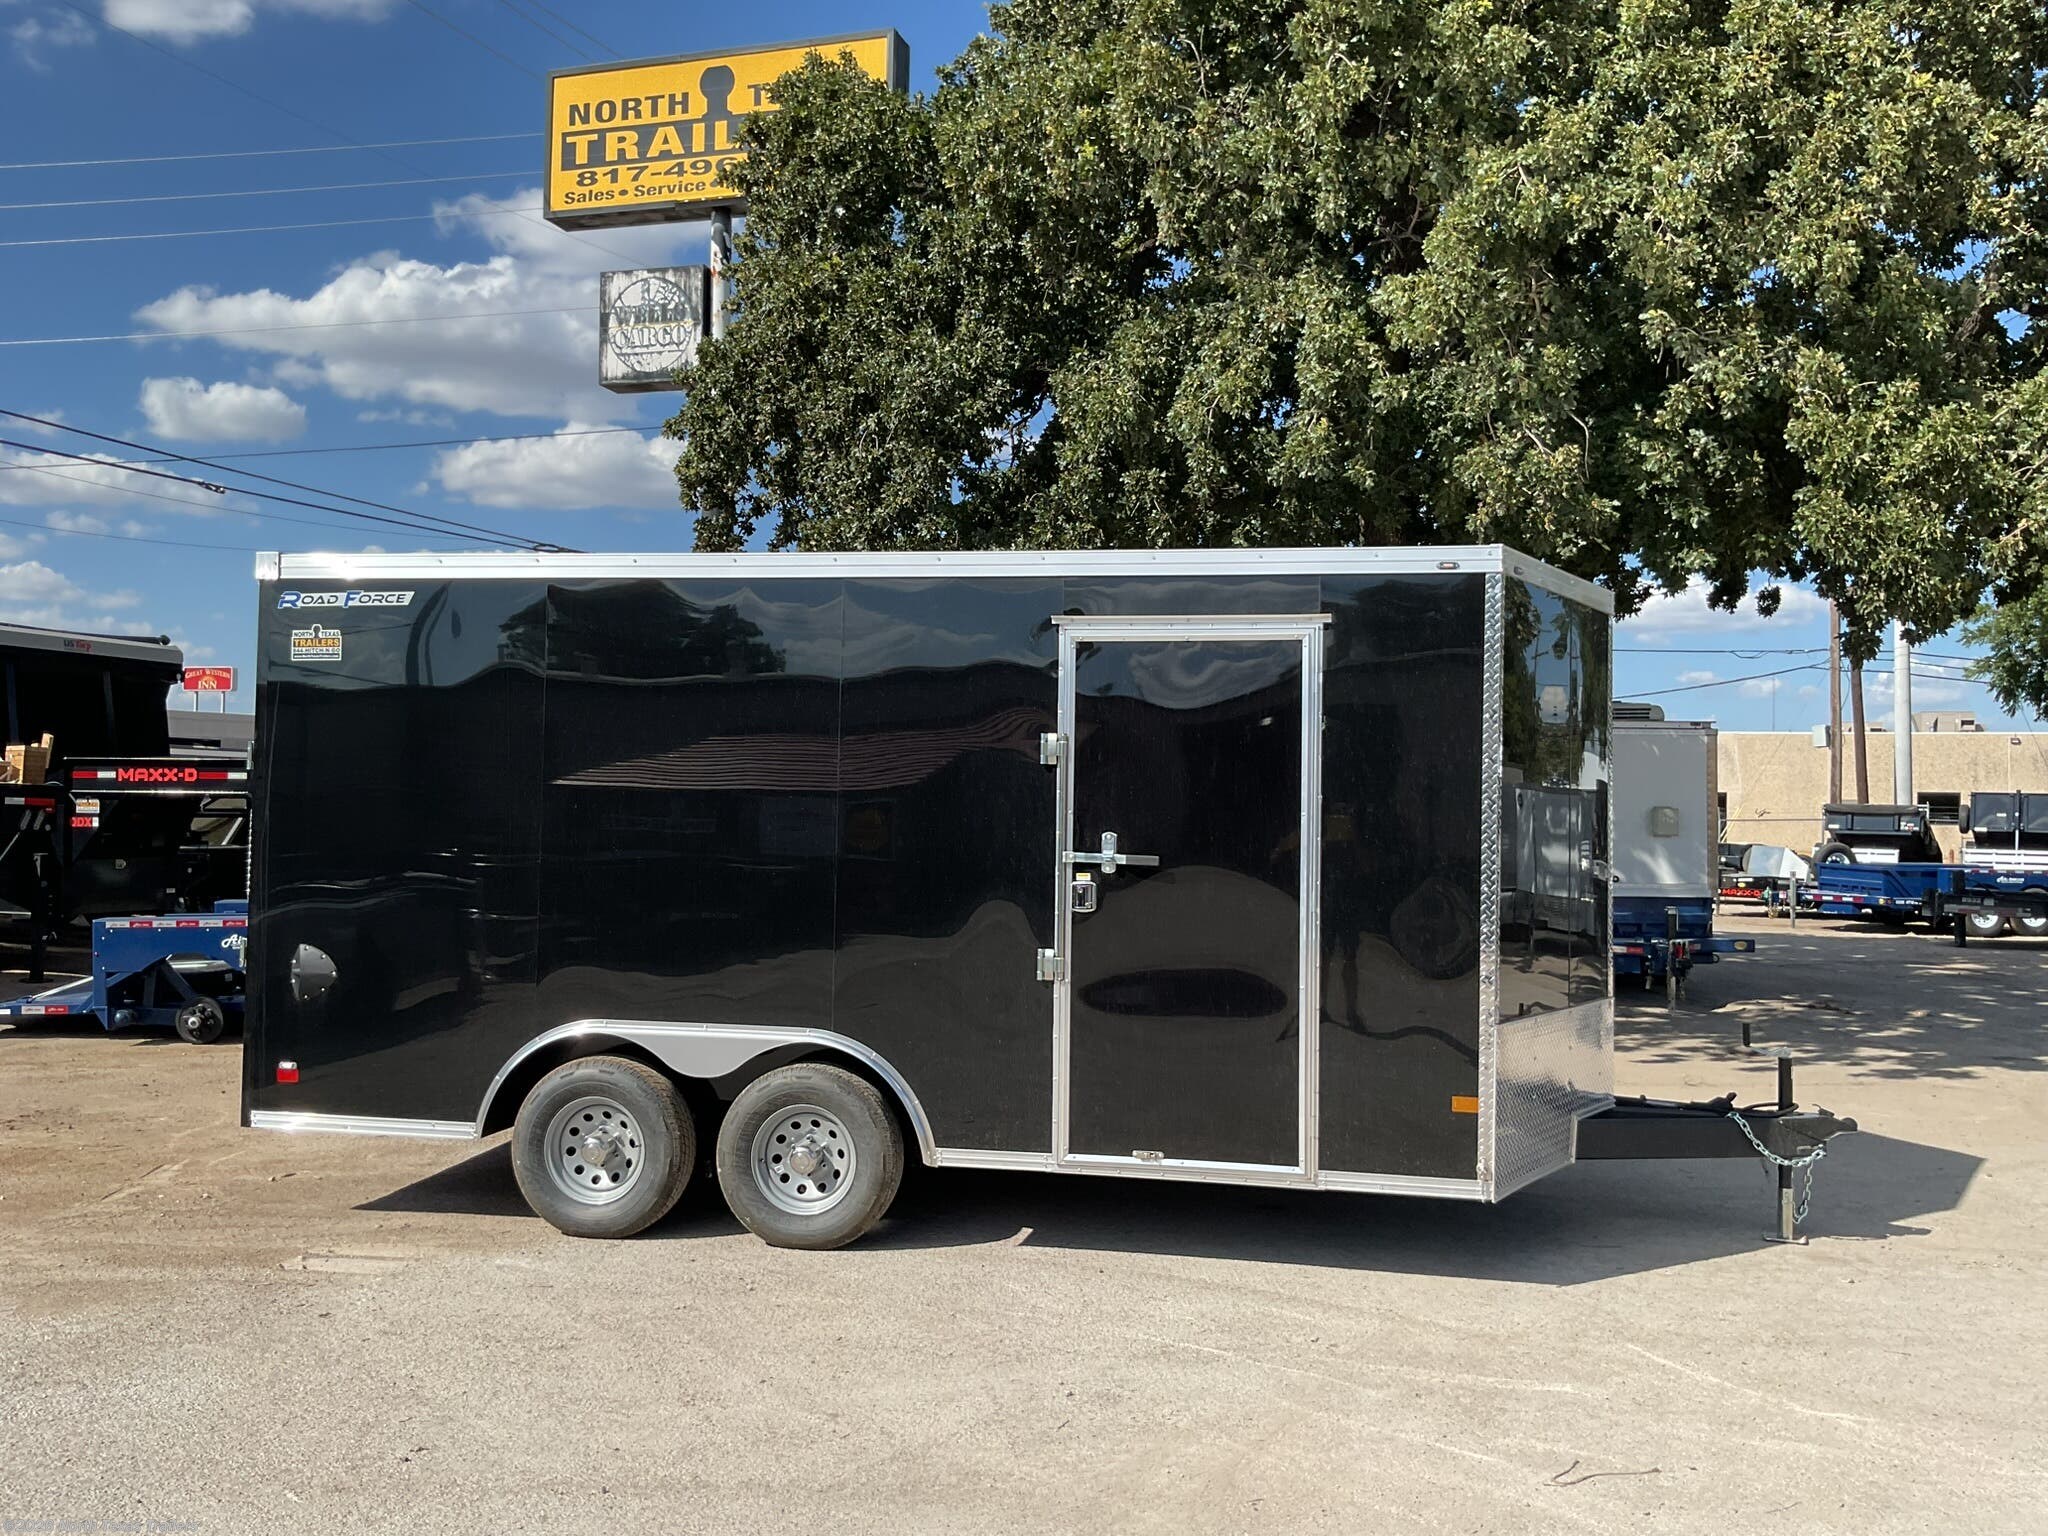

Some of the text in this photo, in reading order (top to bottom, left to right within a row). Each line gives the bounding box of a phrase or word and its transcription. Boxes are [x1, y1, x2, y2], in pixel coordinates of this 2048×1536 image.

[568, 91, 690, 126] NORTH
[566, 120, 736, 165] TRAIL
[564, 179, 706, 205] Sales Service
[614, 324, 687, 349] CARGO
[294, 638, 340, 647] TRAILERS
[185, 669, 203, 679] GREAT
[198, 680, 218, 690] INN
[117, 768, 197, 782] MAXX-D
[1722, 889, 1761, 897] MAXX-D
